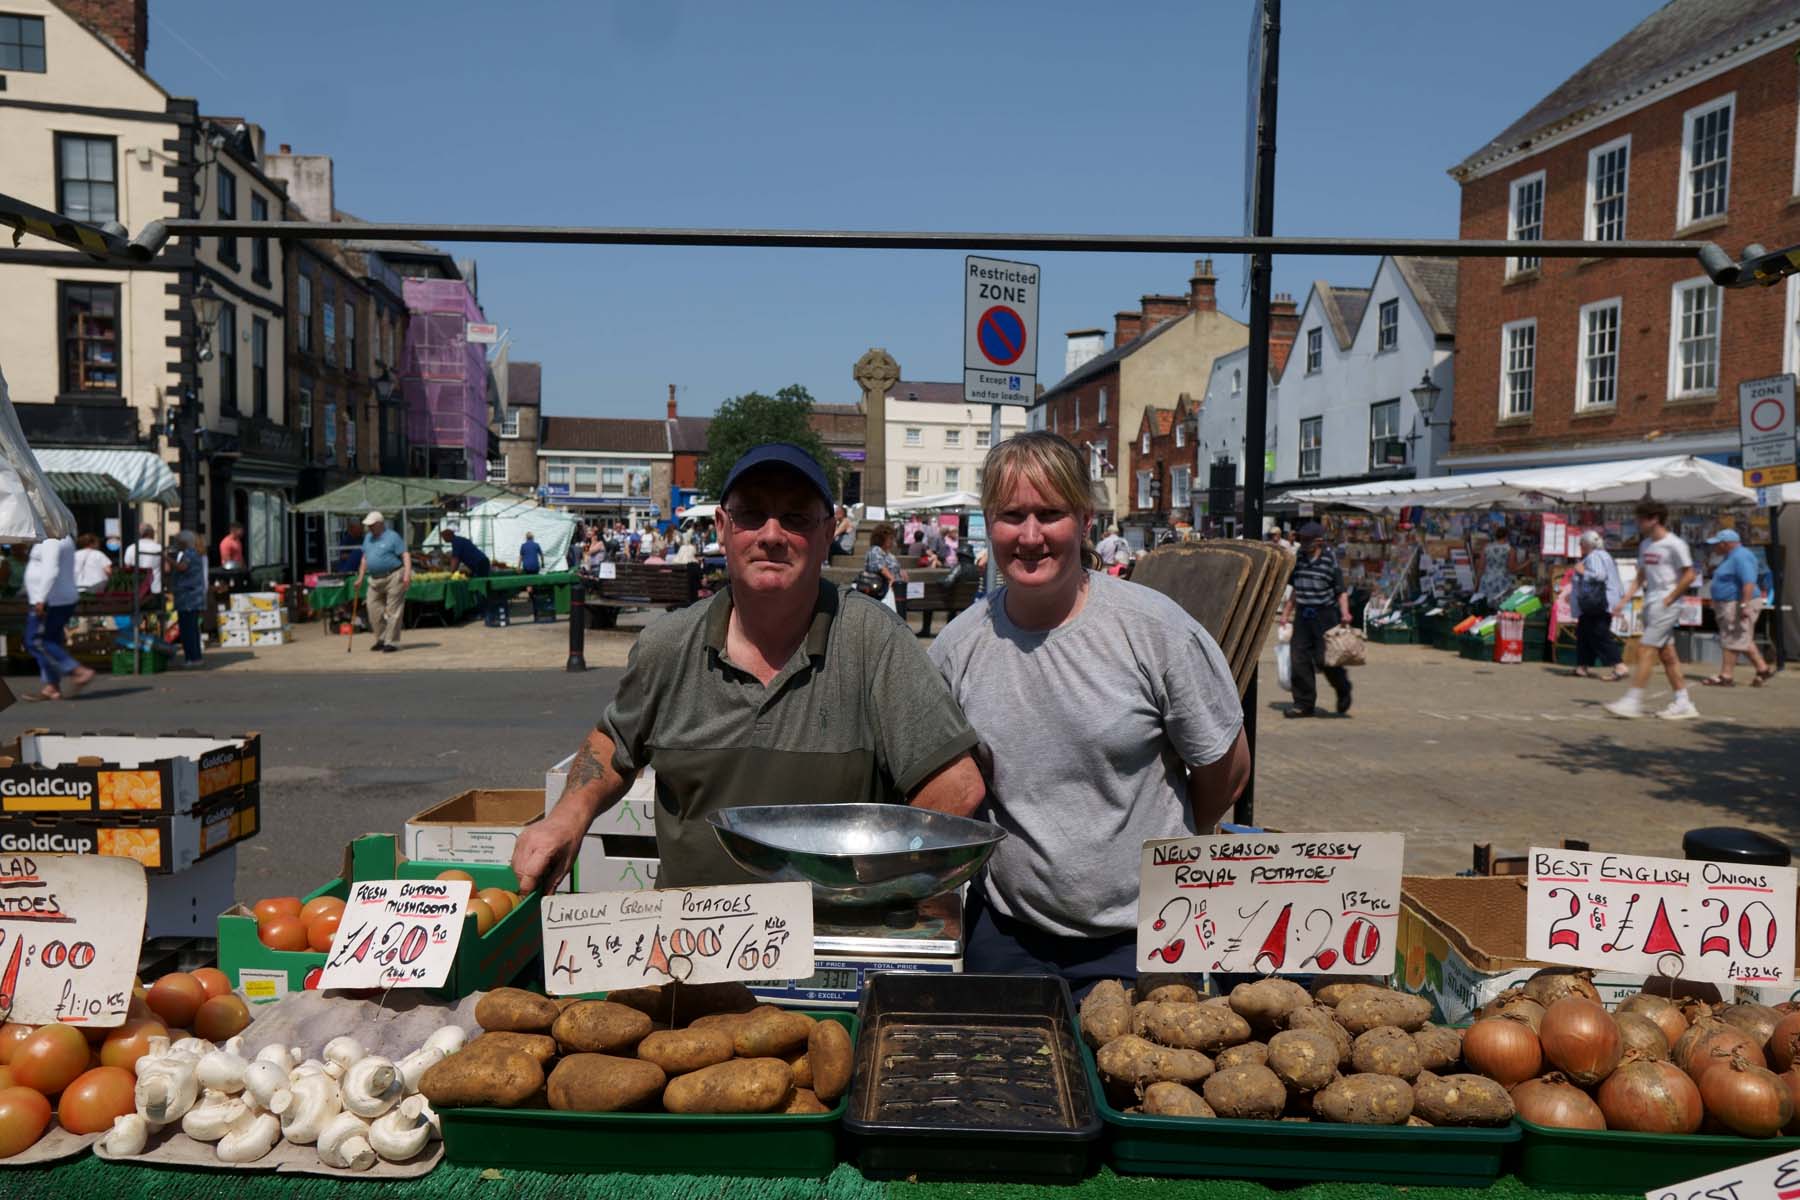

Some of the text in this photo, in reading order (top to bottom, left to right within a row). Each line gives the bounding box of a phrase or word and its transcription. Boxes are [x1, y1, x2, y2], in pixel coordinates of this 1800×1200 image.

[970, 264, 1036, 285] Restricted
[979, 283, 1026, 303] ZONE
[979, 375, 1007, 385] Except
[971, 390, 1029, 403] and for loading
[1751, 385, 1784, 398] ZONE
[1, 778, 92, 800] GoldCup
[1, 834, 92, 854] GoldCup
[1153, 842, 1361, 865] NEW SEASON JERSEY
[1175, 865, 1336, 888] ROYAL POTATOES
[1535, 853, 1768, 888] BEST ENGLISH ONIONS
[355, 883, 447, 902] FRESH BUTTON
[385, 900, 457, 914] MUSHROOMS
[620, 896, 663, 915] GROWN
[681, 892, 751, 913] POTATOES
[1548, 887, 1581, 951] 2
[1587, 892, 1608, 905] LBS
[1148, 896, 1192, 964] 2
[552, 939, 582, 984] 4
[822, 970, 849, 989] 330
[1763, 967, 1782, 978] KG
[818, 992, 843, 1000] EXCELL
